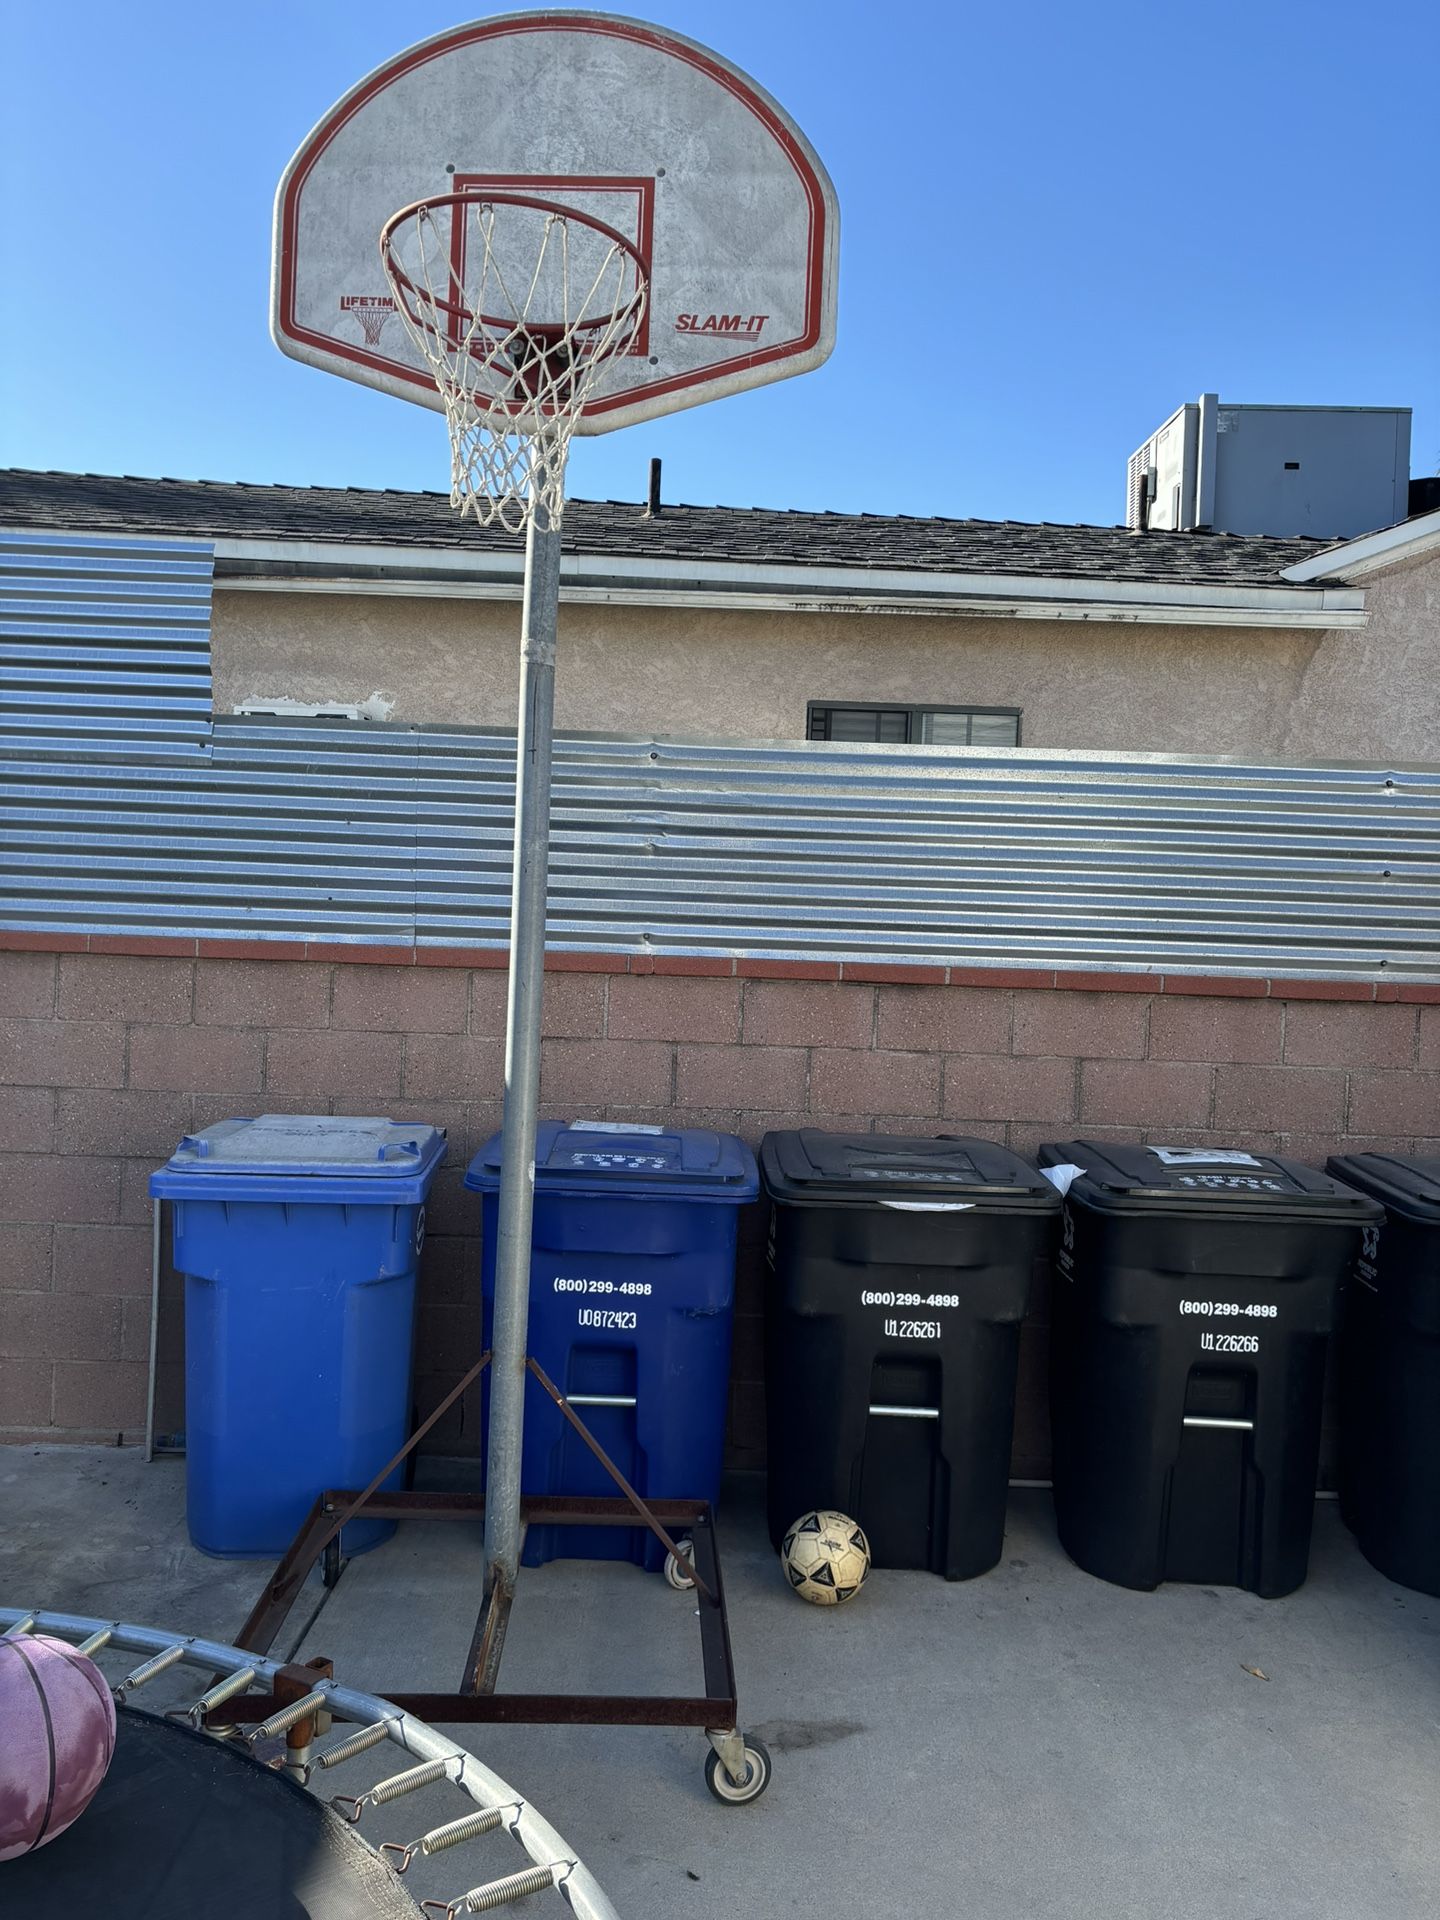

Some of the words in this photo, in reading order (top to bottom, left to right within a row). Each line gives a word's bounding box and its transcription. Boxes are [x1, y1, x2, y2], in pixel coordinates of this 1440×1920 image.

[674, 313, 769, 331] SLAM-IT
[553, 1277, 652, 1296] (800)299-4898
[861, 1290, 959, 1307] (800)299-4898
[1179, 1299, 1278, 1318] (800)299-4898
